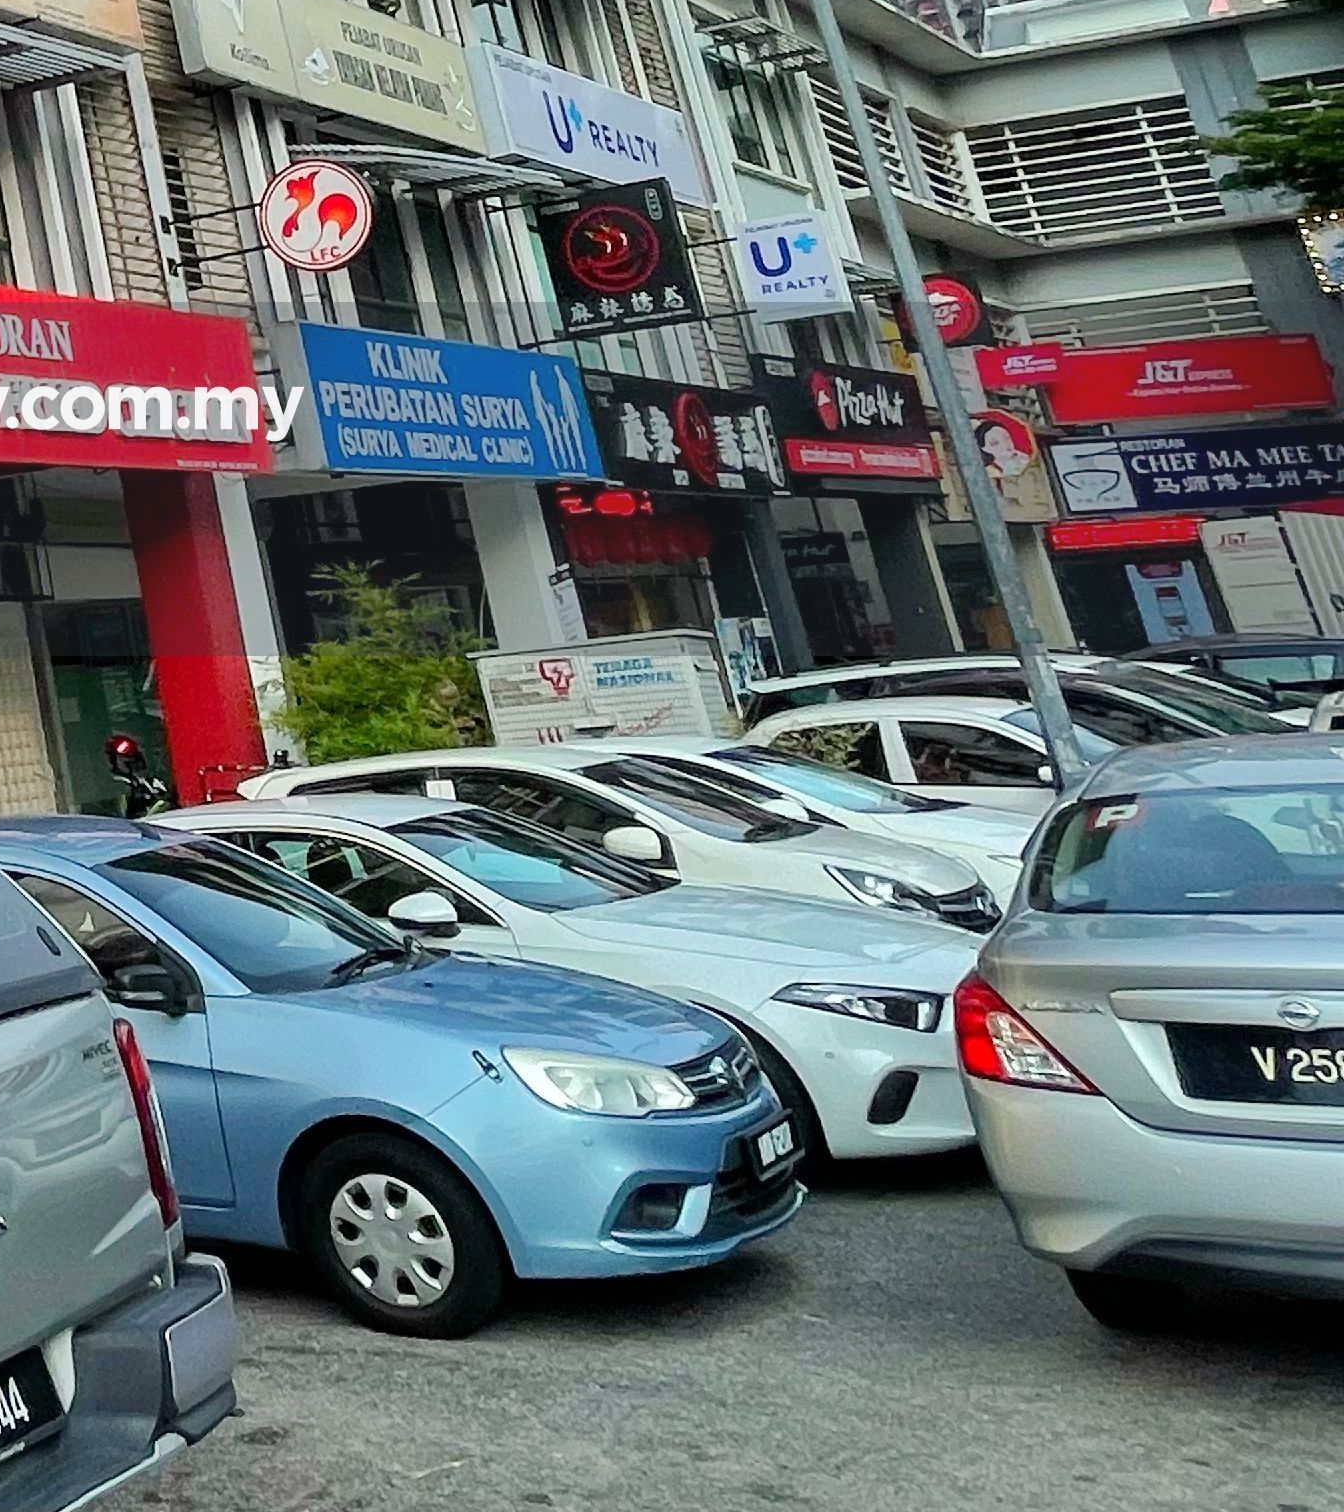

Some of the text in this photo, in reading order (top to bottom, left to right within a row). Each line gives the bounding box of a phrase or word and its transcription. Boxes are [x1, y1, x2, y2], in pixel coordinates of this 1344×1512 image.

[588, 120, 659, 166] REALTY
[310, 246, 341, 261] LFC
[762, 275, 828, 294] REALTY
[366, 340, 448, 385] KLINIK
[1137, 359, 1193, 384] J&T
[319, 380, 530, 430] PERUBATAN SURYA
[835, 376, 904, 427] Pizza Hut
[338, 423, 403, 458] (SURYA
[407, 431, 478, 462] MEDICAL
[1131, 452, 1197, 474] CHEF
[1206, 450, 1251, 469] MA
[1256, 445, 1313, 466] MEE
[1250, 1046, 1275, 1082] V
